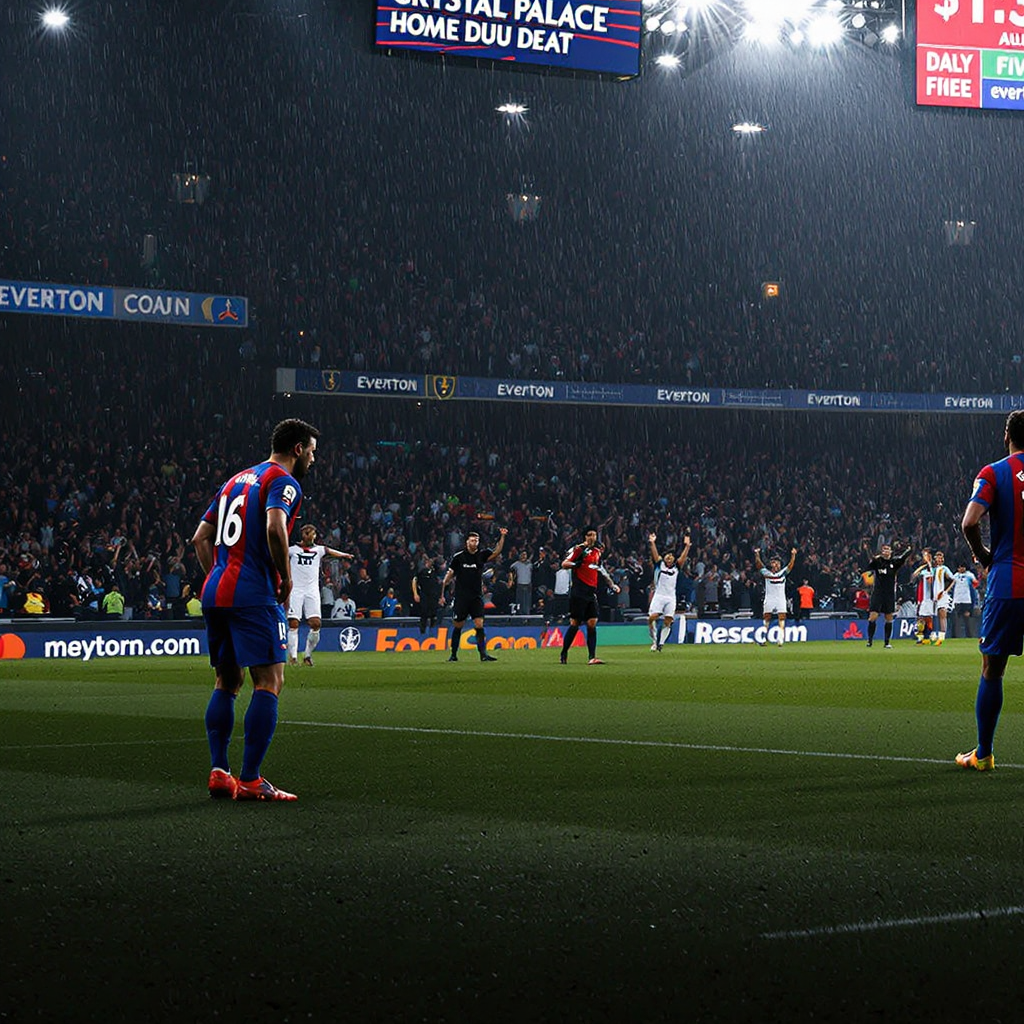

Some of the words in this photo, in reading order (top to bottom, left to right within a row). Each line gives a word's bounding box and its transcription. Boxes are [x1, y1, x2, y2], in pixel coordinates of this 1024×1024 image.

[389, 11, 460, 42] HOME
[464, 20, 513, 47] DUU
[516, 27, 574, 55] DEAT
[926, 51, 974, 74] DALY
[0, 285, 103, 311] EVERTON
[214, 494, 246, 547] 16
[44, 635, 200, 662] meytorn.com
